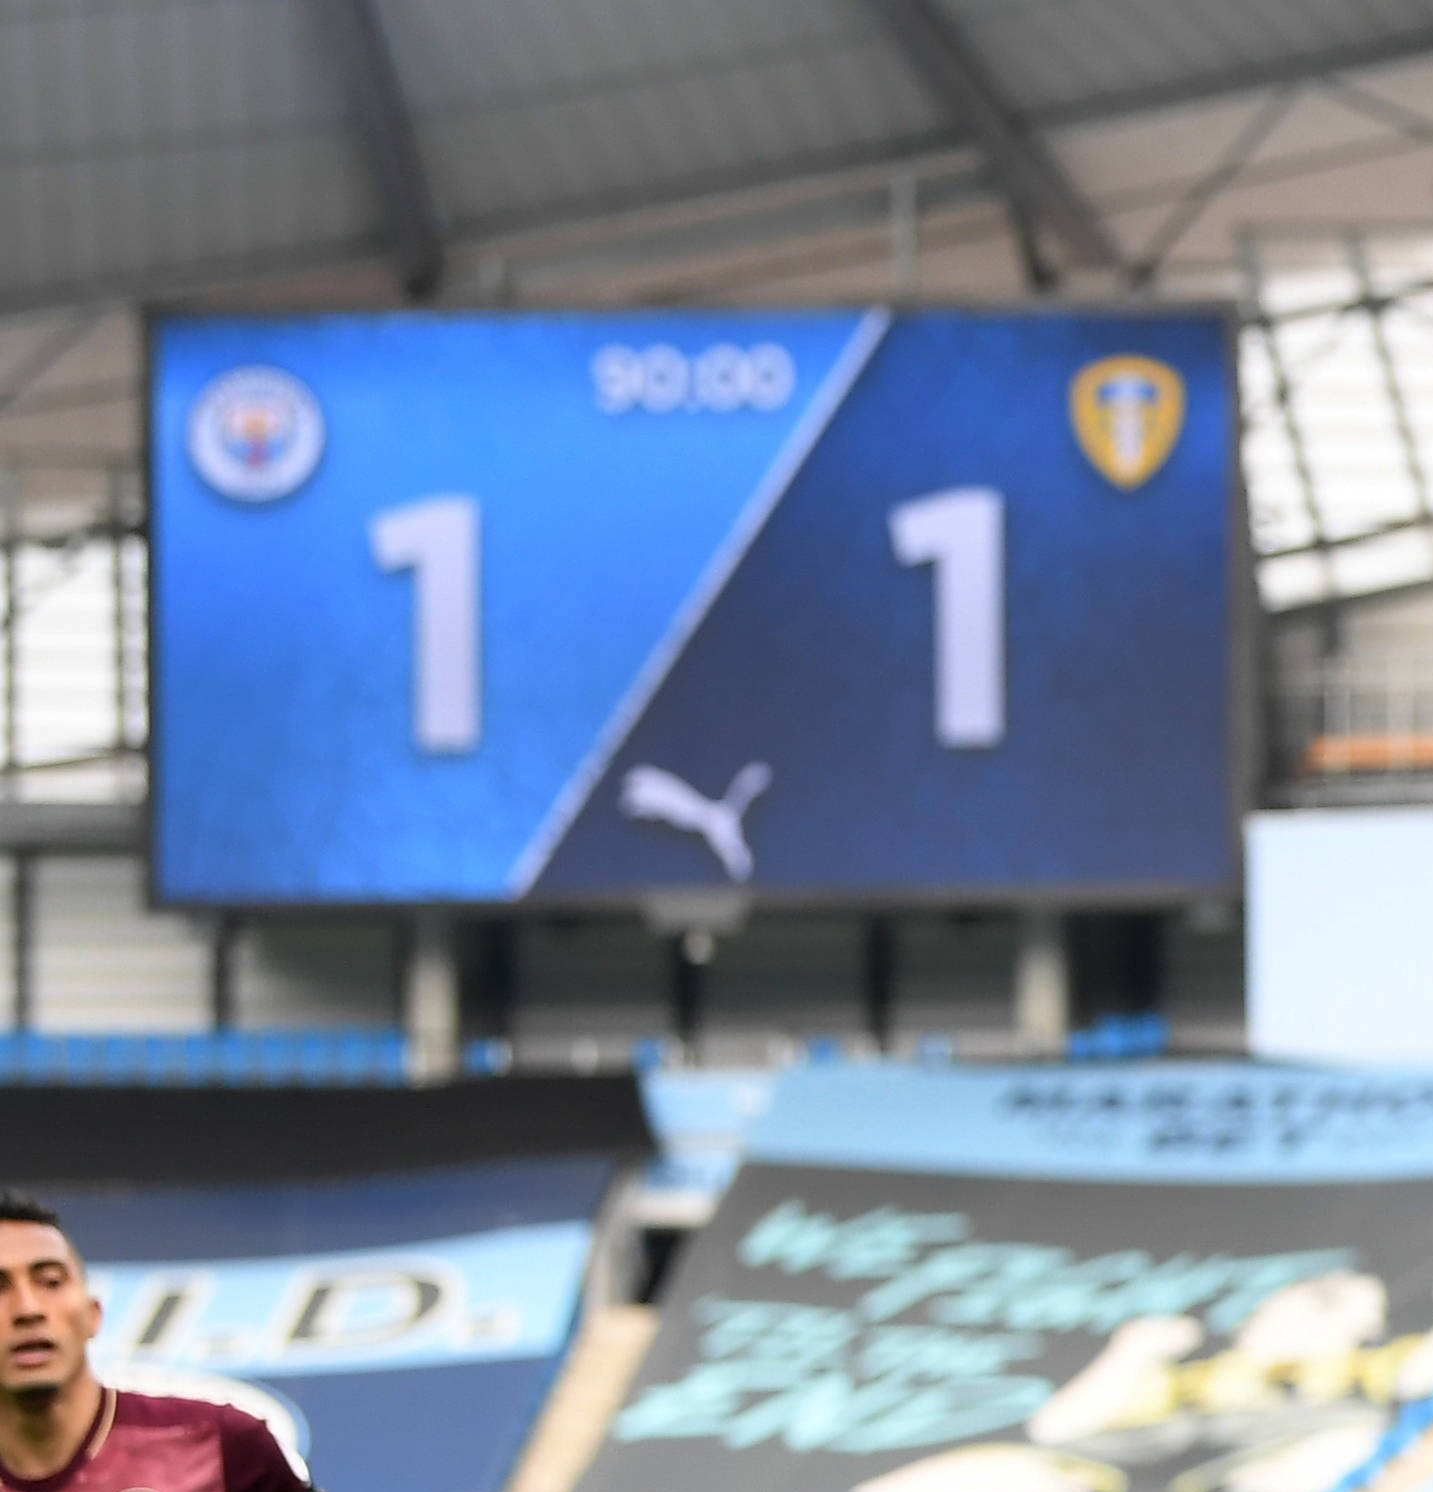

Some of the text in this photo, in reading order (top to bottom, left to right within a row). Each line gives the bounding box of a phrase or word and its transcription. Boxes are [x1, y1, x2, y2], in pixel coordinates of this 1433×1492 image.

[590, 342, 797, 415] 90:00
[367, 490, 482, 755] 1
[889, 483, 1004, 750] 1
